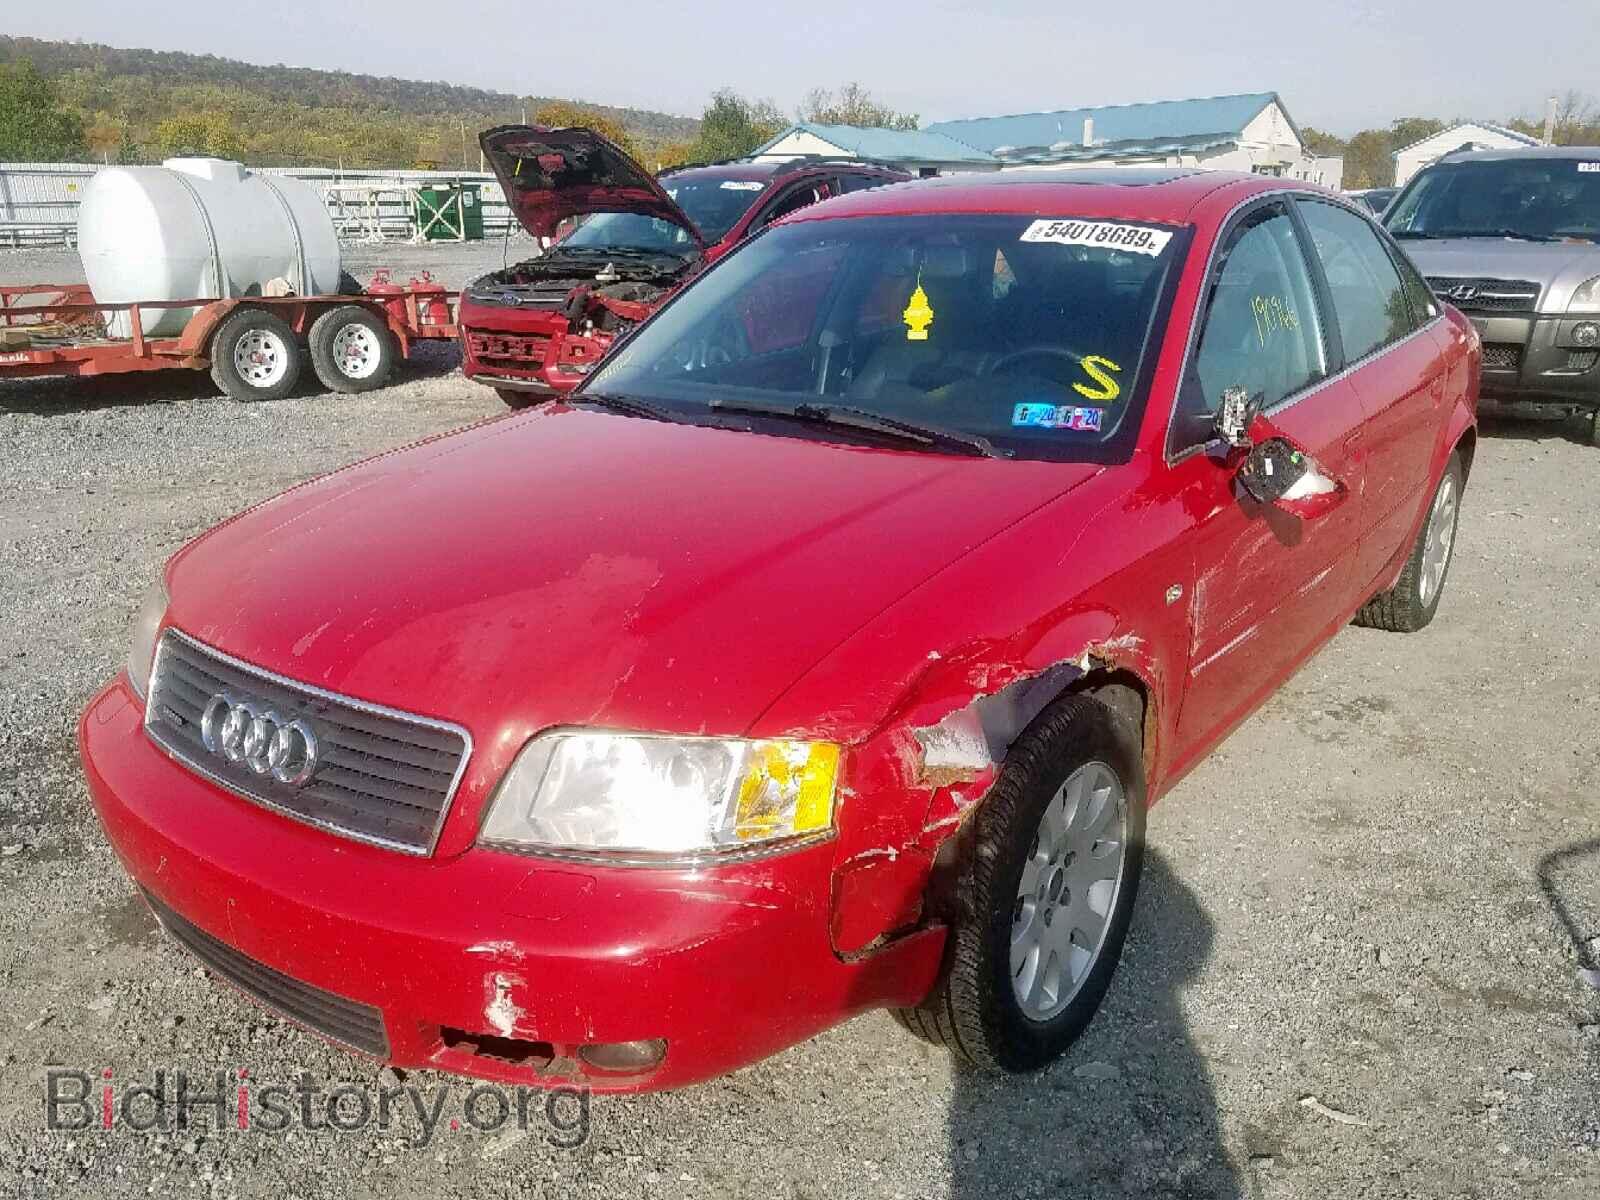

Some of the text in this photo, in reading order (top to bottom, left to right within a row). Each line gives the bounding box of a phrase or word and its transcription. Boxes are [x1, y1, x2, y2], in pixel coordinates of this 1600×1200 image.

[1044, 222, 1151, 248] 54018689
[1071, 355, 1122, 400] S
[1086, 410, 1099, 425] 20
